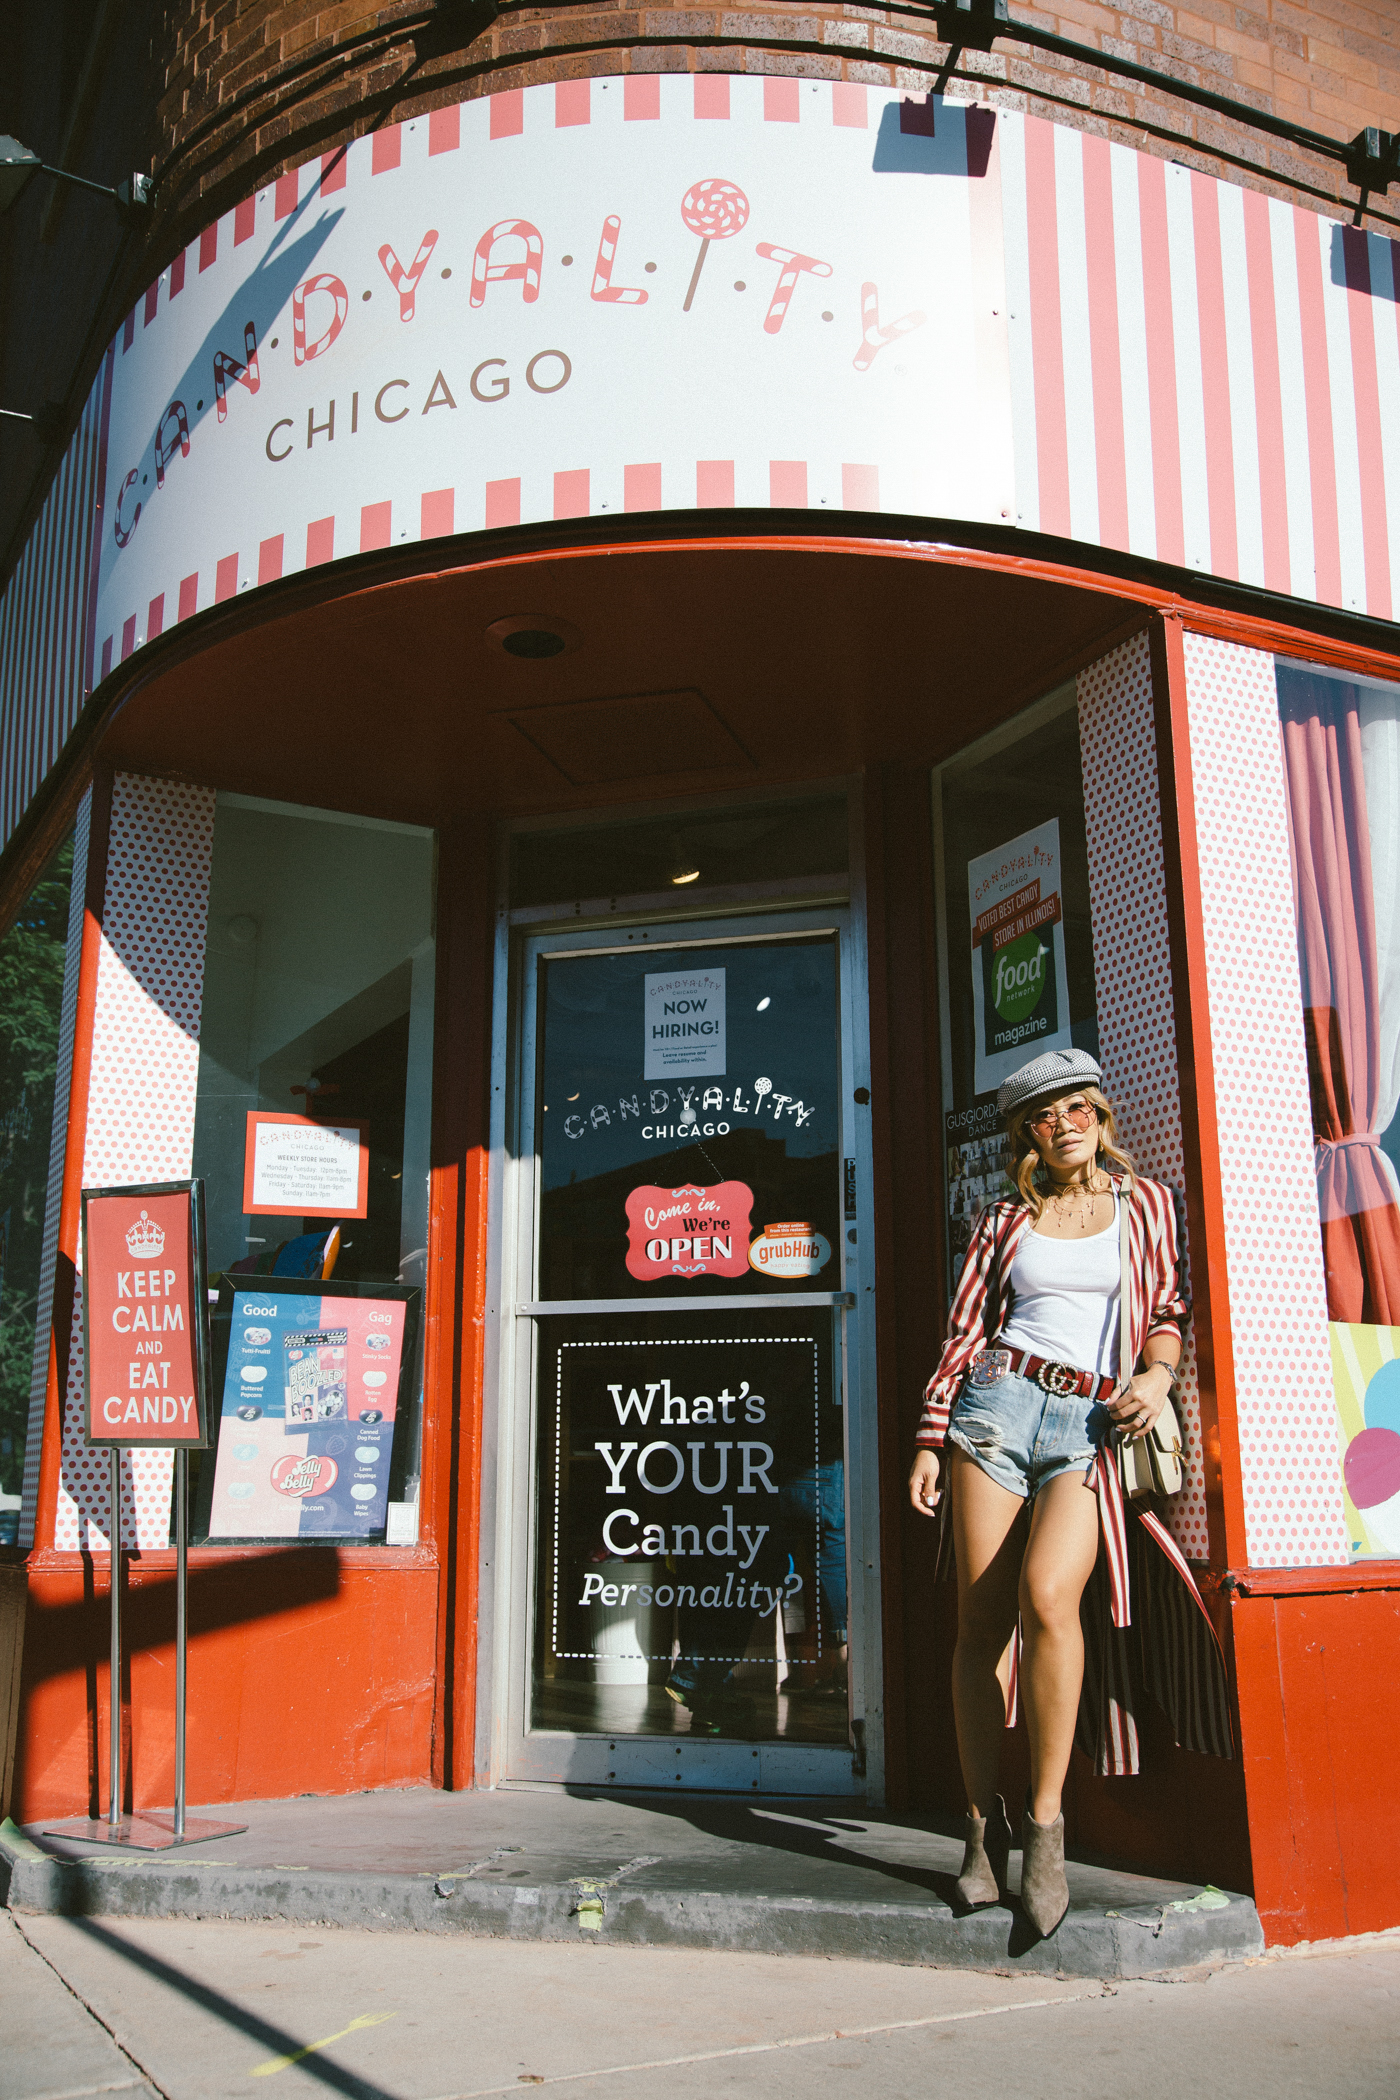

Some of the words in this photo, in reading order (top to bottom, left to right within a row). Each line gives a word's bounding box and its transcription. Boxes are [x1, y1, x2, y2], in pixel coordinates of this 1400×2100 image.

[265, 348, 573, 463] CHICAGO
[999, 873, 1028, 892] CHICAGO
[978, 909, 998, 932] VOTED
[998, 898, 1015, 919] BEST
[1015, 883, 1038, 909] CANDY
[994, 923, 1016, 947] STORE
[1016, 917, 1025, 934] IN
[1025, 899, 1056, 929] ILLINOIS!
[995, 943, 1042, 1009] food
[1006, 985, 1035, 1002] network
[664, 998, 708, 1016] NOW
[652, 1020, 719, 1039] HIRING!
[994, 1017, 1047, 1046] magazine
[641, 1122, 730, 1140] CHICAGO
[968, 1119, 997, 1137] DANCE
[290, 1143, 325, 1151] CHICAGO
[261, 1172, 293, 1180] Wednesday
[266, 1164, 288, 1172] Monday
[644, 1202, 692, 1230] Come
[698, 1197, 721, 1212] in,
[682, 1217, 731, 1232] We're
[645, 1235, 732, 1262] OPEN
[759, 1240, 820, 1265] grubHub
[117, 1269, 176, 1298] KEEP
[112, 1304, 184, 1333] CALM
[243, 1303, 277, 1317] Good
[368, 1311, 392, 1326] Gag
[135, 1341, 163, 1355] AND
[129, 1362, 171, 1389] EAT
[289, 1352, 321, 1385] BEAN
[240, 1391, 262, 1399] Popcorn
[291, 1369, 342, 1404] BOOZLED
[103, 1396, 193, 1424] CANDY
[606, 1379, 767, 1425] What's
[292, 1455, 322, 1478] Jelly
[594, 1441, 779, 1495] YOUR
[279, 1474, 315, 1498] Belly
[602, 1505, 770, 1570] Candy
[578, 1572, 803, 1618] Personality?
